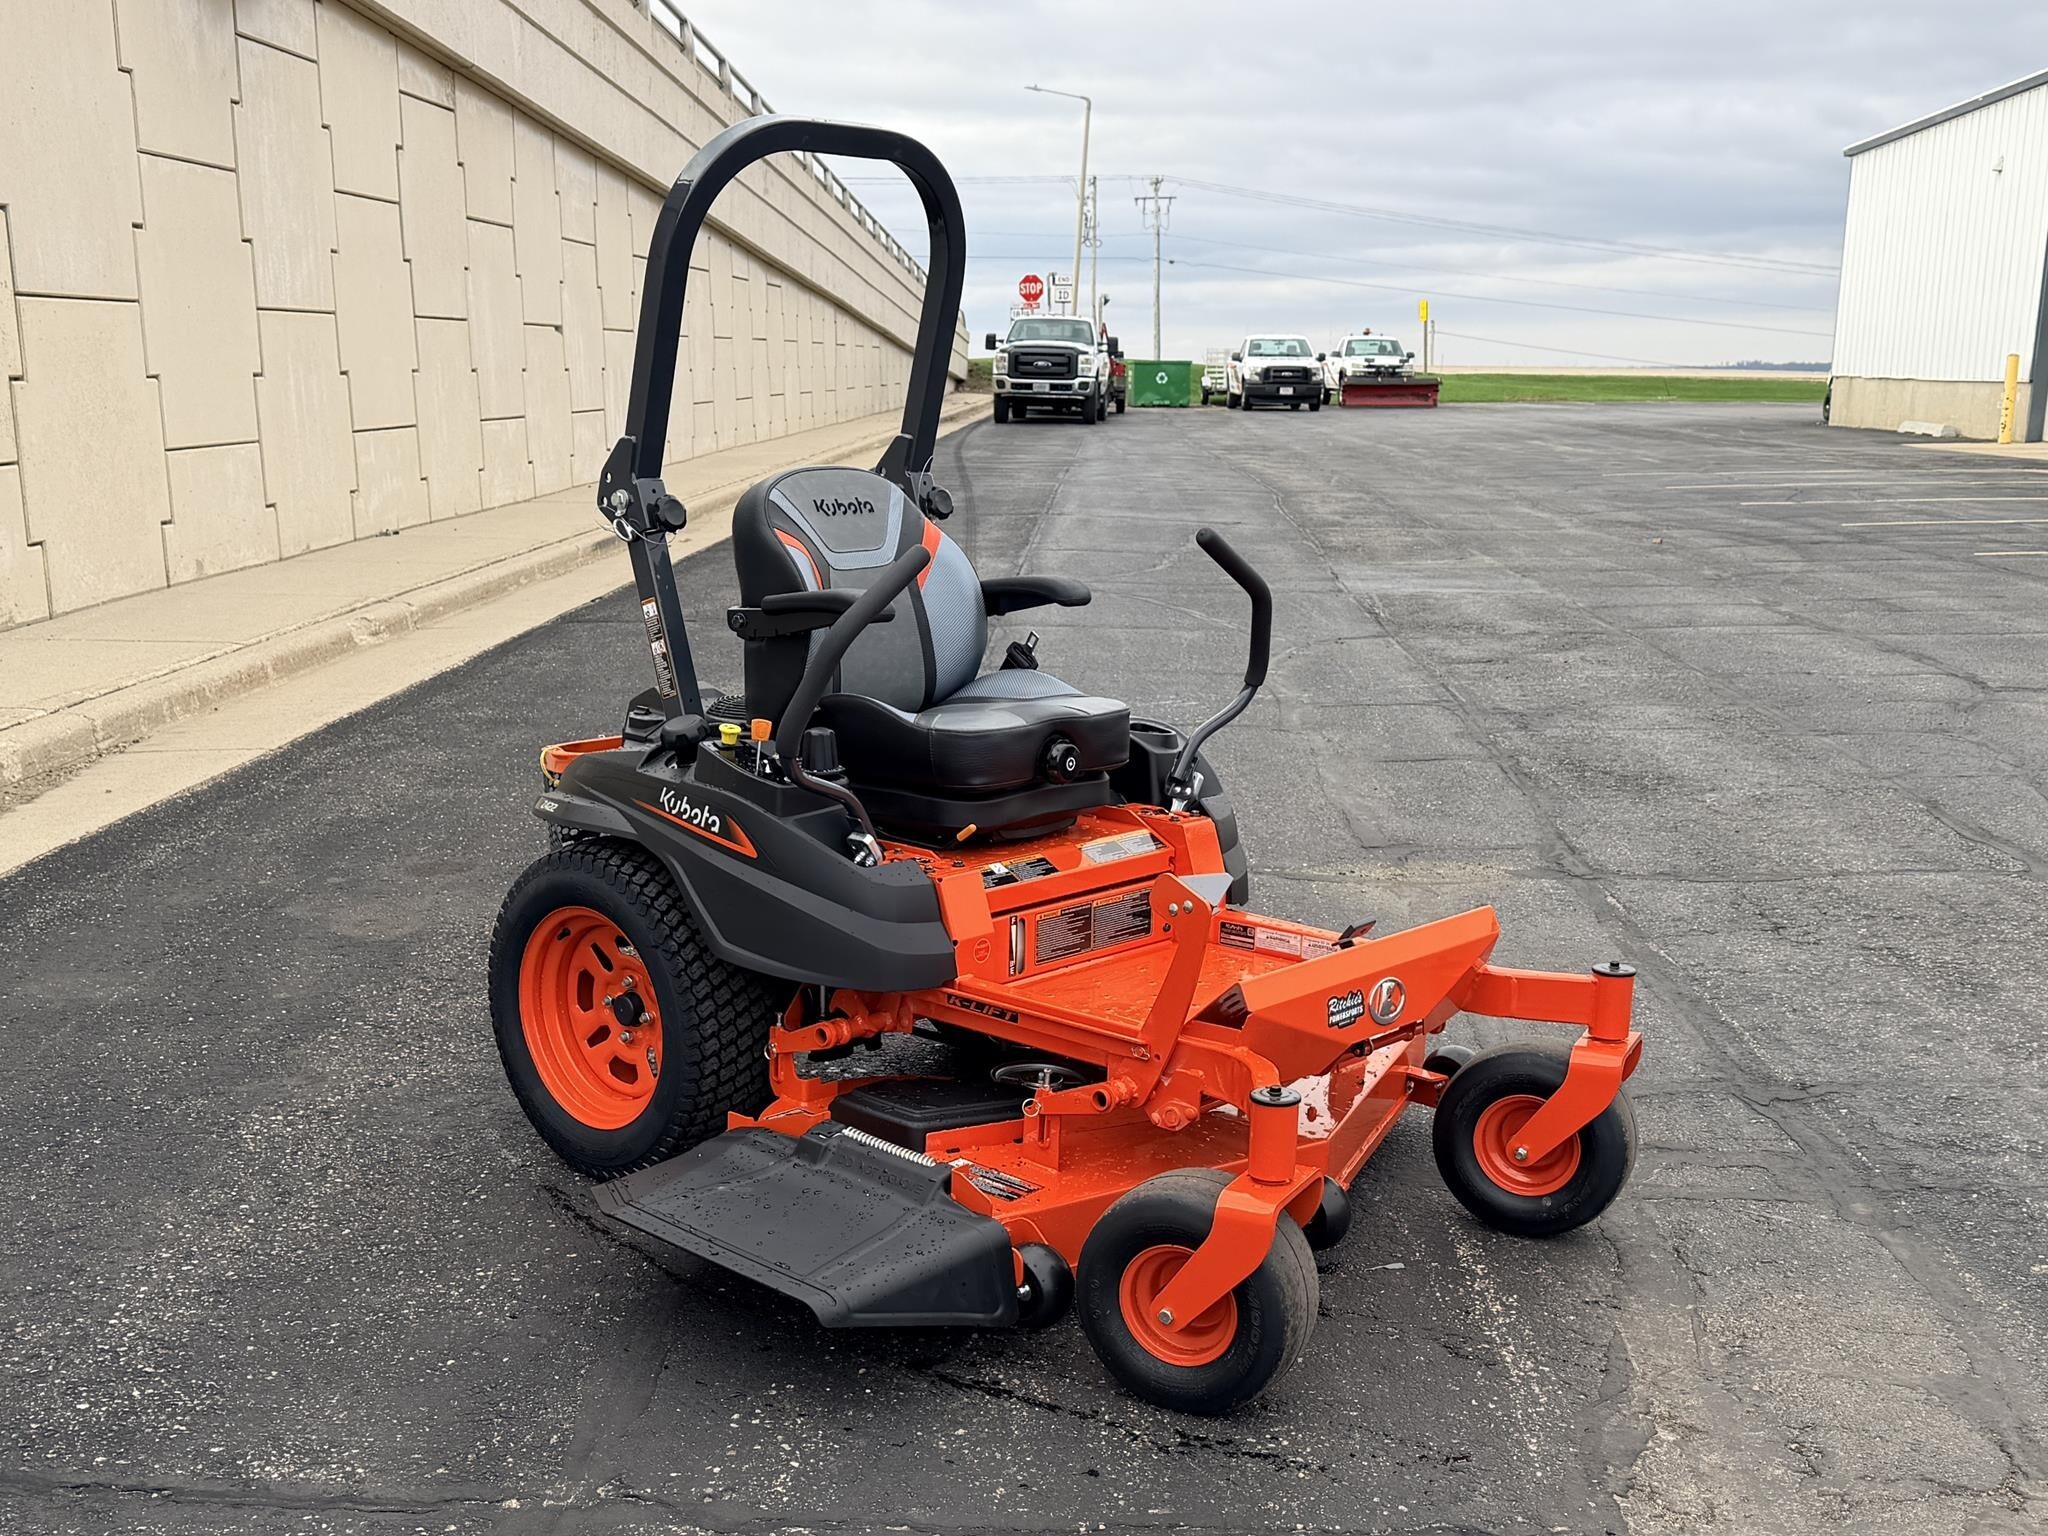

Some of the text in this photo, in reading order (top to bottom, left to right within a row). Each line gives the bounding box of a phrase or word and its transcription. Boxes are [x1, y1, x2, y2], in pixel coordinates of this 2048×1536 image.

[1020, 282, 1043, 294] STOP
[813, 497, 875, 517] Kubota
[659, 786, 721, 834] Kubota
[949, 996, 1017, 1021] K-LIFT
[1328, 991, 1362, 1015] Ritchie's
